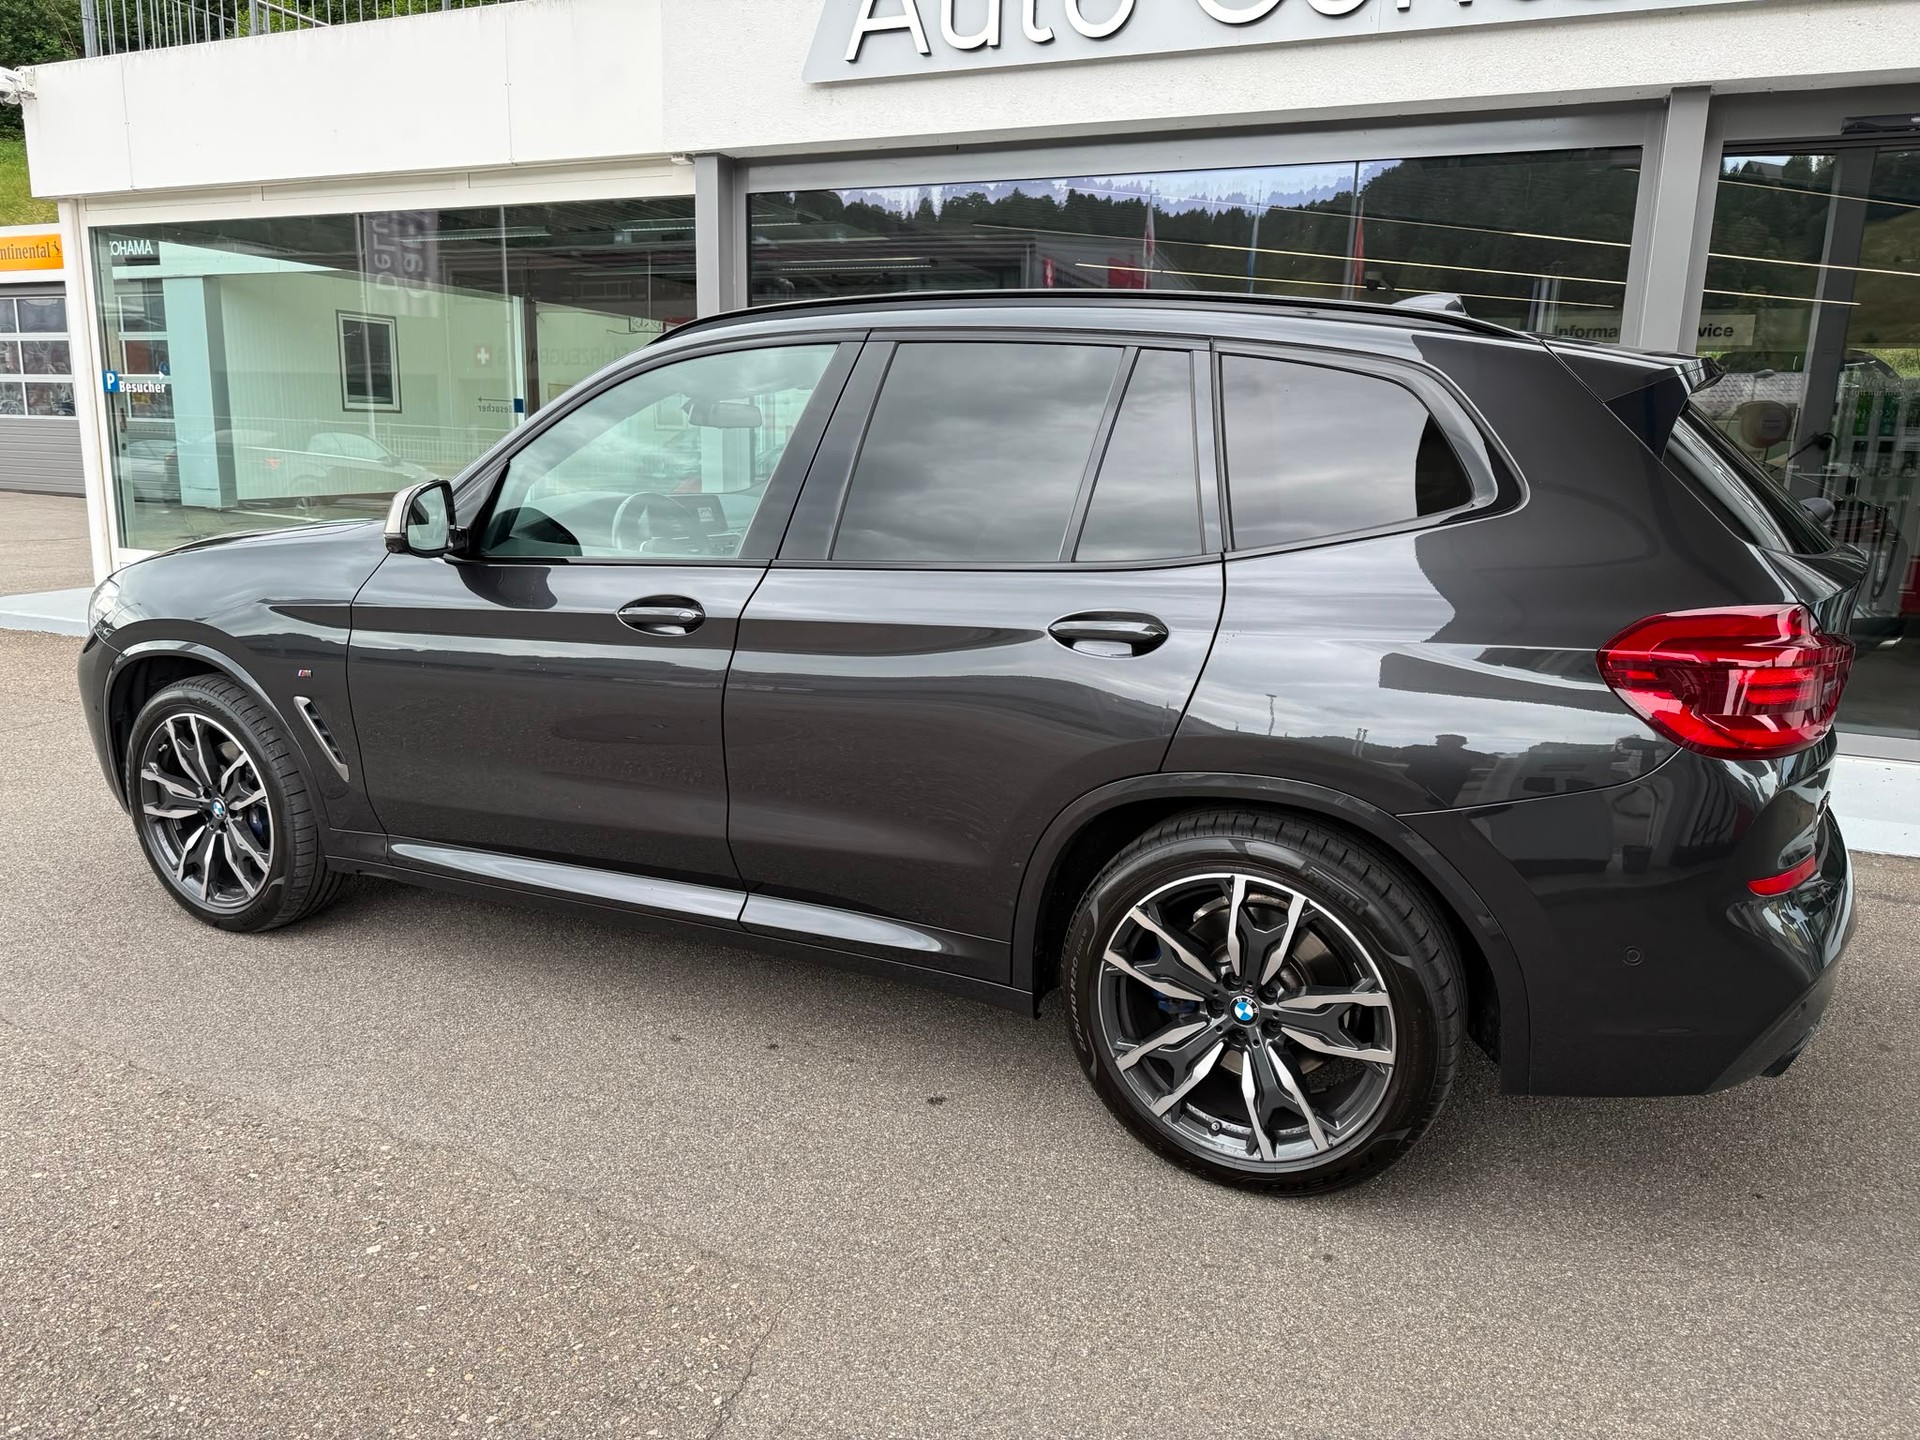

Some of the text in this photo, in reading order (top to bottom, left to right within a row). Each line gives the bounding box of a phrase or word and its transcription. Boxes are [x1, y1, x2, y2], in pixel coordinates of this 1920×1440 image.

[0, 241, 51, 260] ntinental
[110, 239, 153, 256] OHAMA
[1555, 323, 1734, 338] Informa vice
[119, 381, 166, 393] Besucher
